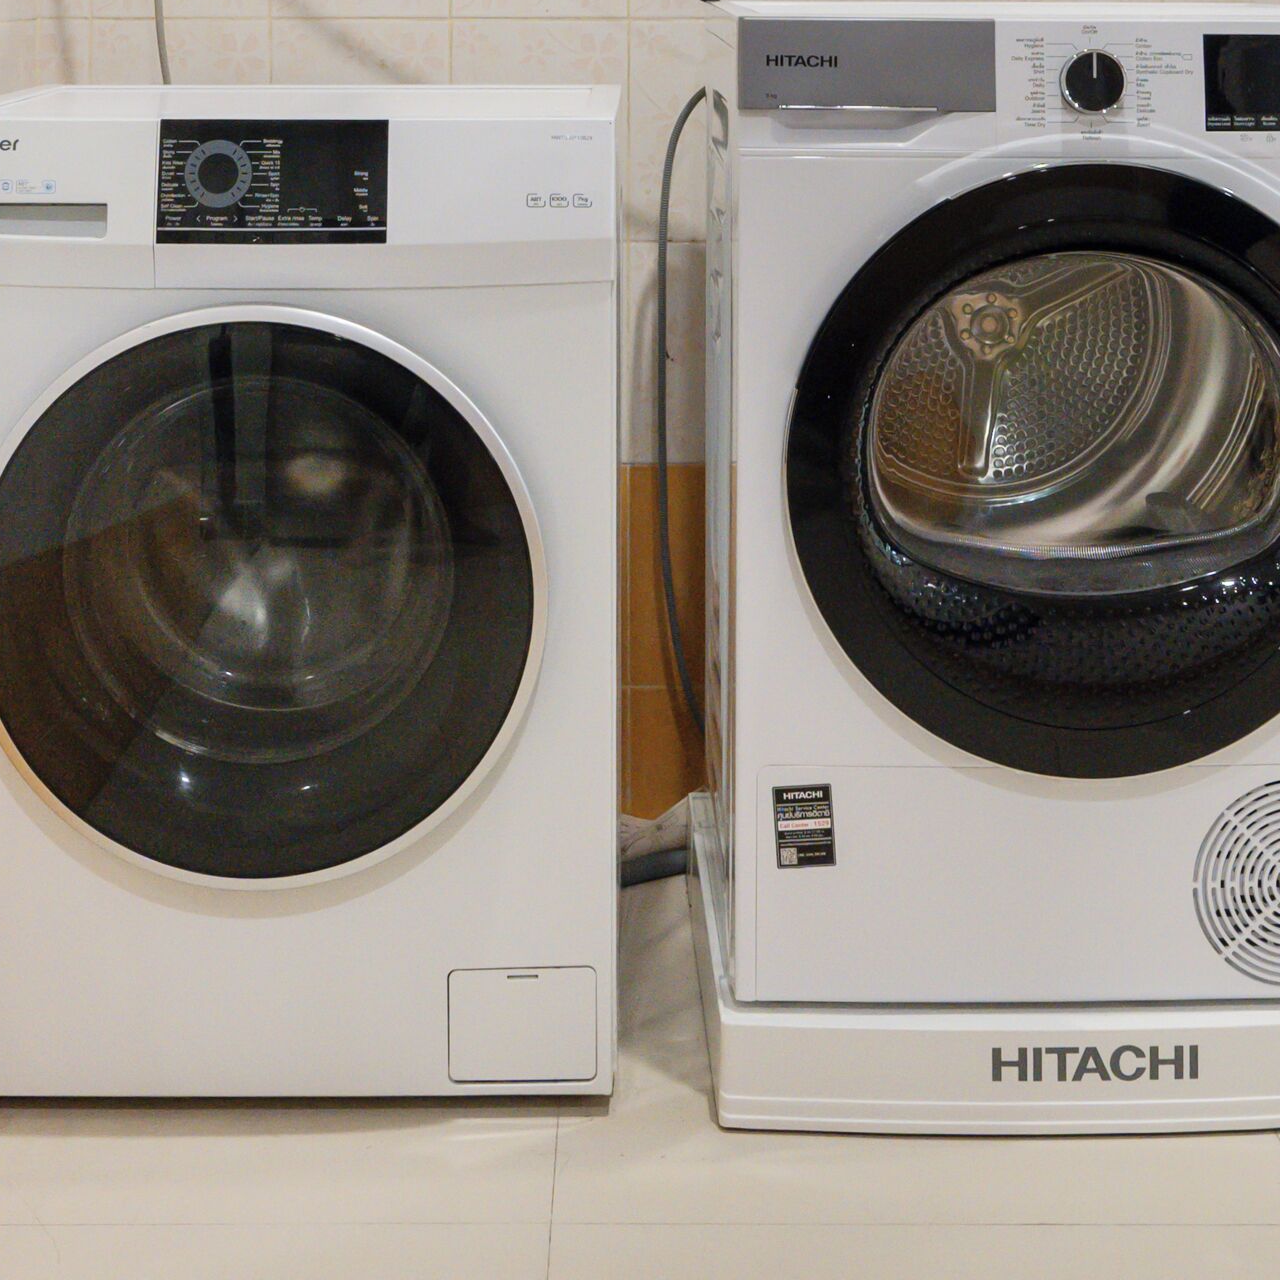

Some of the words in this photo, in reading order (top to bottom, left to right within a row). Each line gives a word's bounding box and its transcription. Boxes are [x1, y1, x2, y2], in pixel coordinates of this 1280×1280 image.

[766, 55, 838, 68] HITACHI
[783, 791, 823, 800] HITACHI
[991, 1045, 1199, 1082] HITACHI
